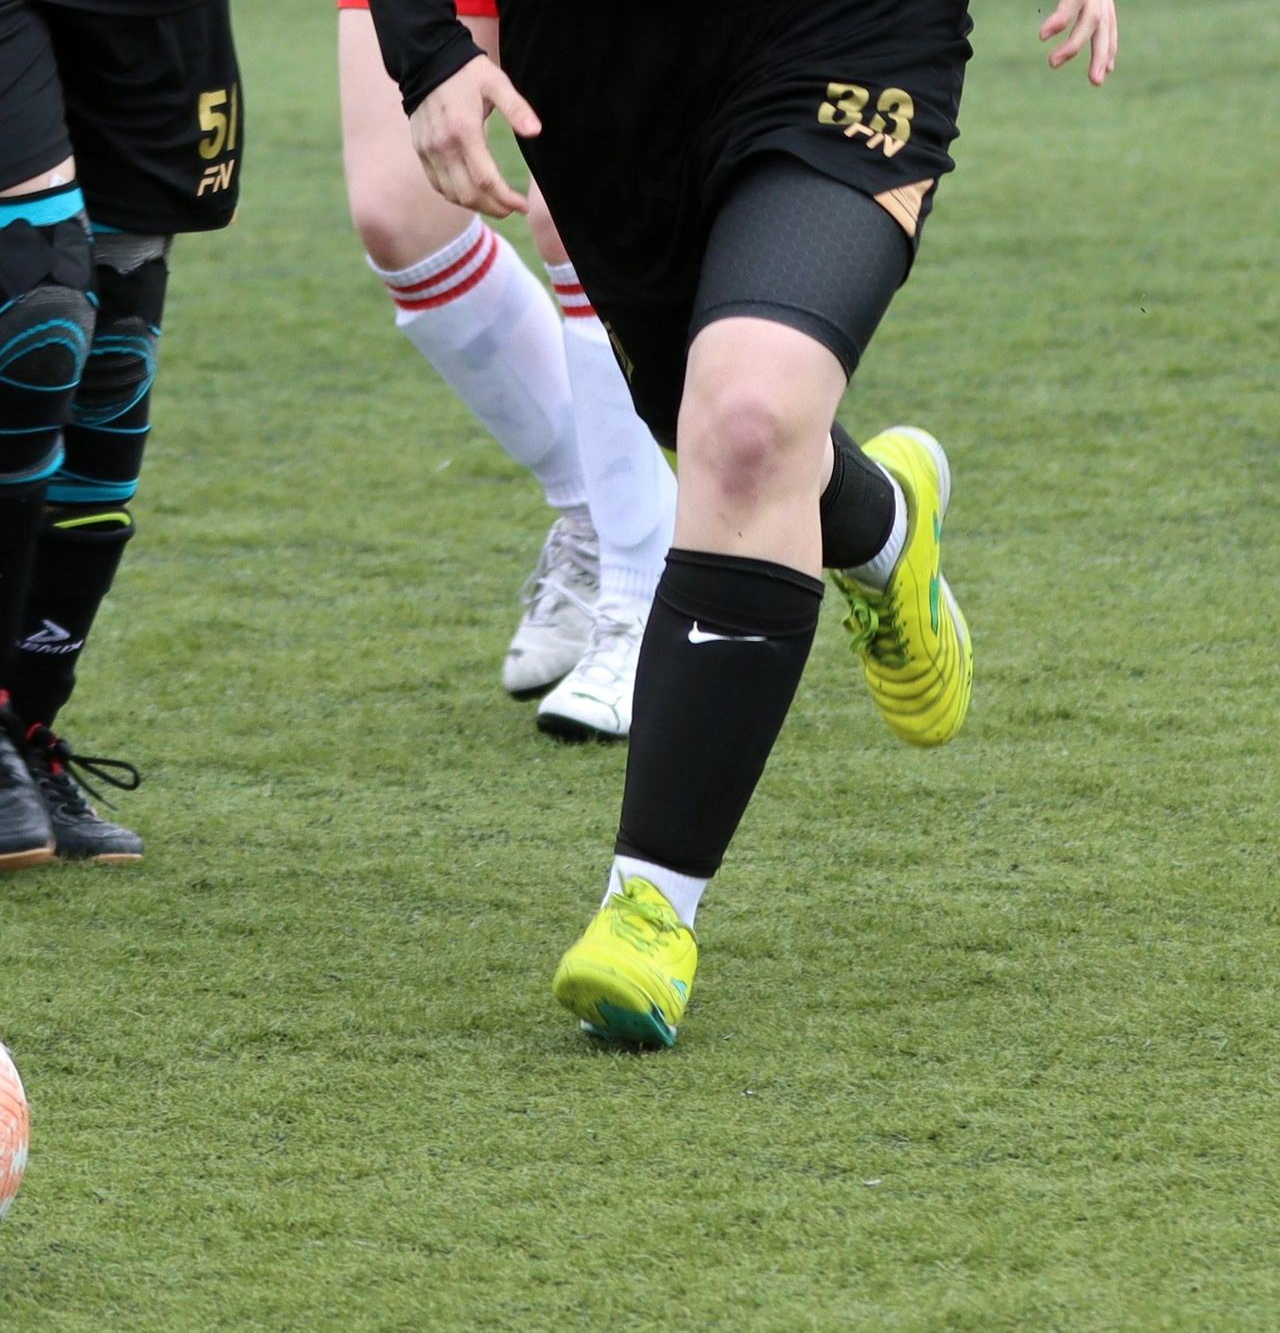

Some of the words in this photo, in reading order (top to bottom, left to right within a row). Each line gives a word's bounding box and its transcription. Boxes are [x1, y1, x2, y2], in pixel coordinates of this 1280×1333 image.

[198, 82, 238, 160] 51
[817, 82, 914, 144] 33
[197, 158, 235, 197] FN
